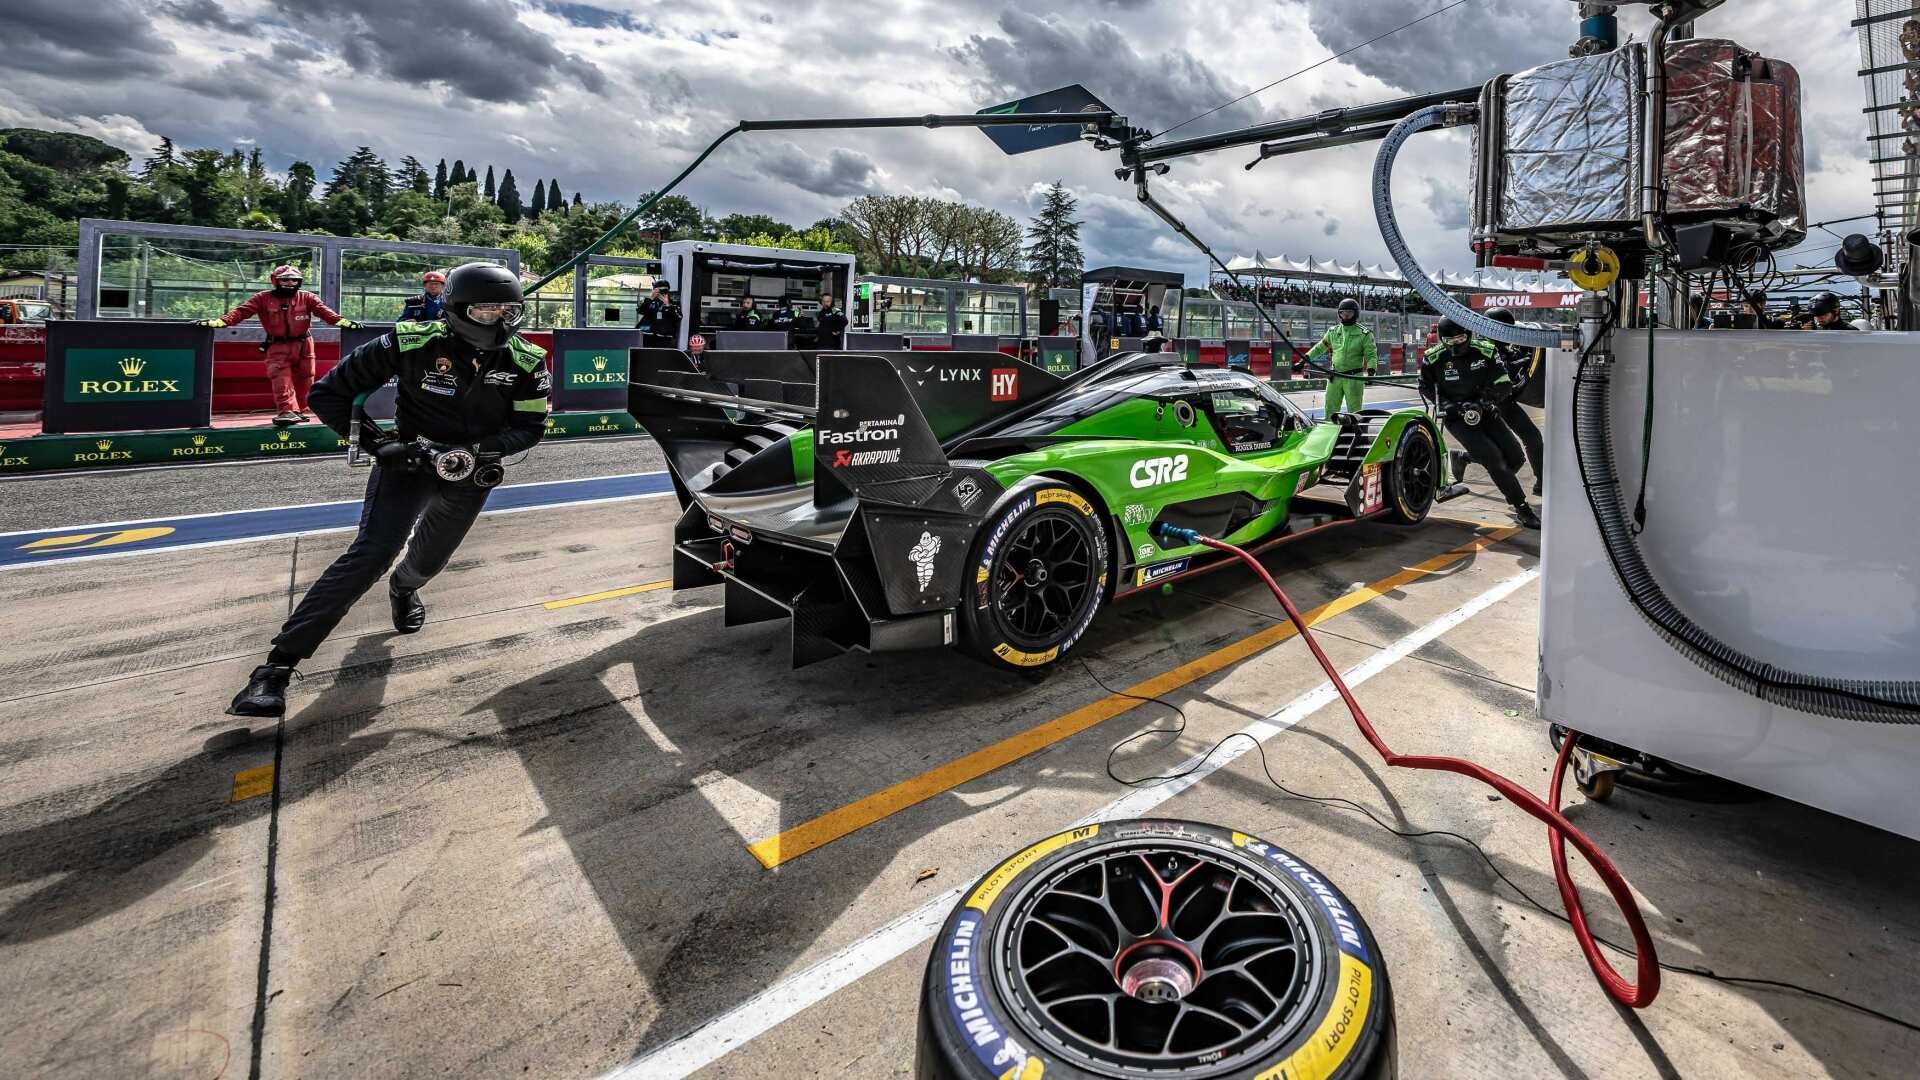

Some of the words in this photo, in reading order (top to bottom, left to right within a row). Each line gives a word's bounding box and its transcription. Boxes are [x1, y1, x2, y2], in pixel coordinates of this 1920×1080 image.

[1483, 295, 1532, 306] MOTUL
[572, 372, 626, 383] ROLEX
[940, 368, 981, 381] LYNX
[79, 380, 180, 394] ROLEX
[992, 374, 1015, 396] HY
[588, 424, 620, 432] ROLEX
[859, 419, 898, 427] PERTAMINA
[818, 428, 898, 445] Fastron
[173, 445, 225, 456] ROLEX
[260, 441, 307, 451] ROLEX
[74, 450, 133, 462] ROLEX
[1129, 454, 1189, 489] CSR2
[987, 498, 1032, 556] MICHELIN
[1152, 563, 1183, 577] MICHELIN
[1073, 827, 1090, 840] M
[978, 873, 1005, 901] PILOT
[1003, 848, 1039, 875] SPORT
[1271, 852, 1362, 950] MICHELIN
[951, 920, 1000, 1048] MICHELIN
[1346, 967, 1362, 1010] PILOT
[1326, 1008, 1355, 1052] SPORT
